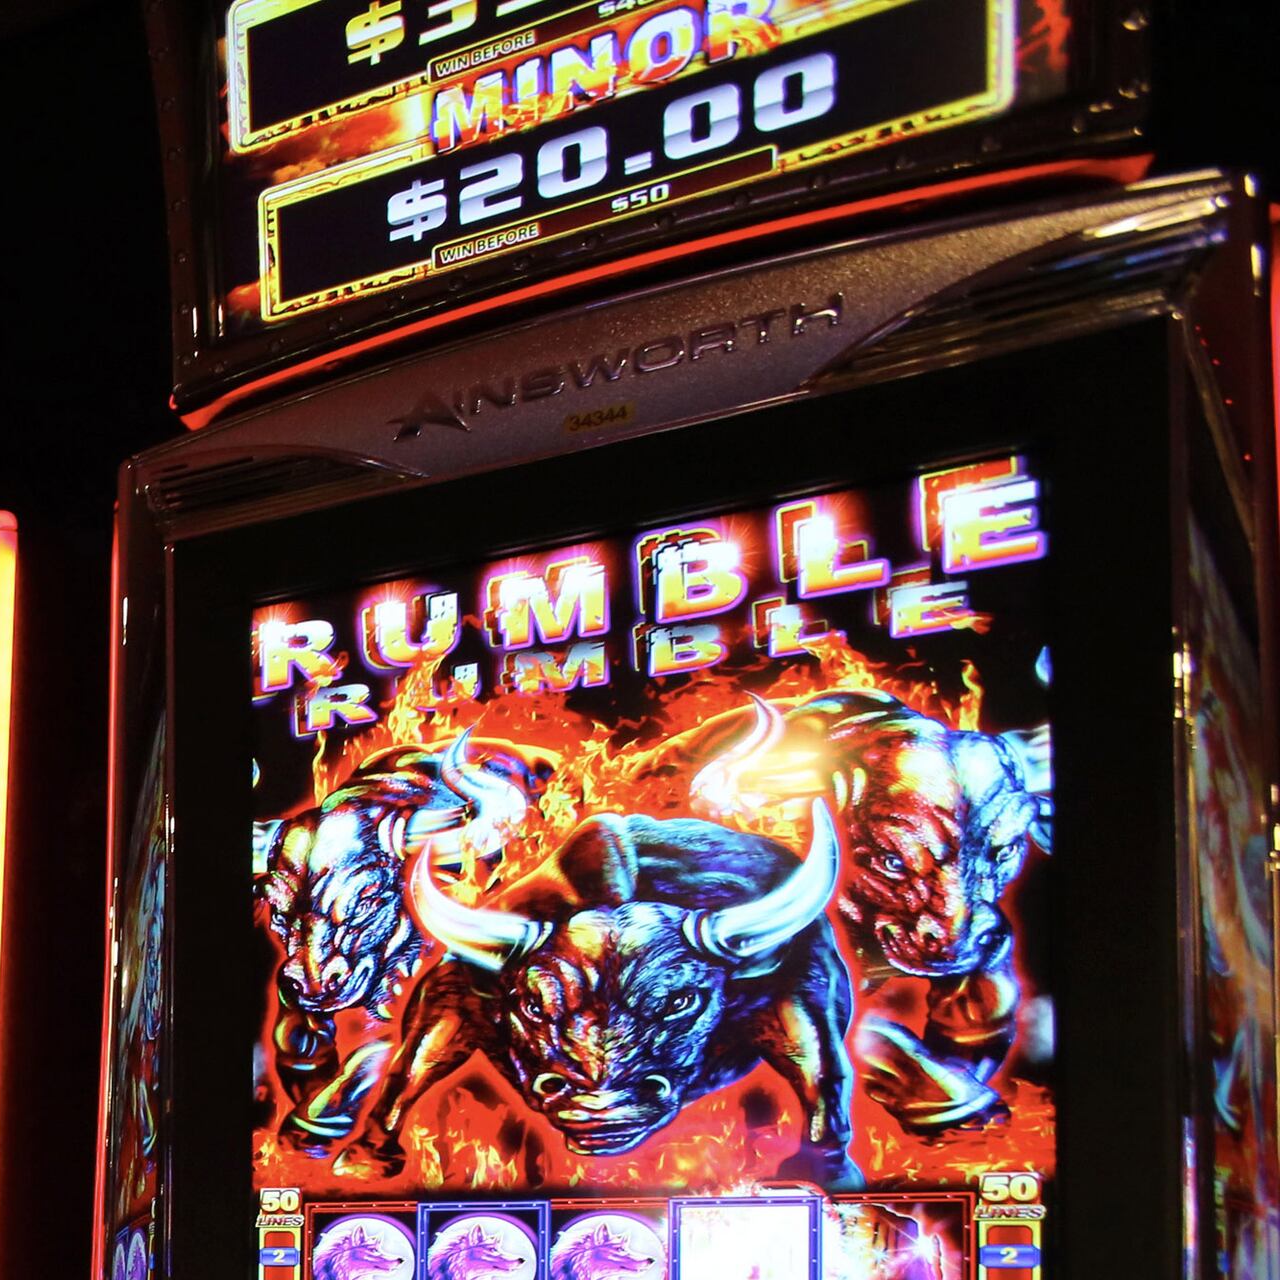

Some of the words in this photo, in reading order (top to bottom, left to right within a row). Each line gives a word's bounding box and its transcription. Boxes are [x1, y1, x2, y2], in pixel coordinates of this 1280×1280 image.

[436, 54, 471, 77] WIN
[472, 33, 534, 67] BEFORE
[430, 0, 780, 153] MINOR
[387, 53, 836, 242] $20.00
[440, 241, 473, 263] WIN
[477, 224, 538, 253] BEFORE
[611, 184, 671, 212] $50
[386, 292, 844, 442] AINSWORTH
[567, 405, 629, 433] 34344
[253, 456, 1043, 698] RUMBLE
[260, 1189, 299, 1213] 50
[982, 1175, 1039, 1201] 50
[256, 1215, 304, 1228] LINES
[974, 1205, 1047, 1221] LINES
[272, 1249, 286, 1264] 2
[1000, 1248, 1018, 1264] 2
